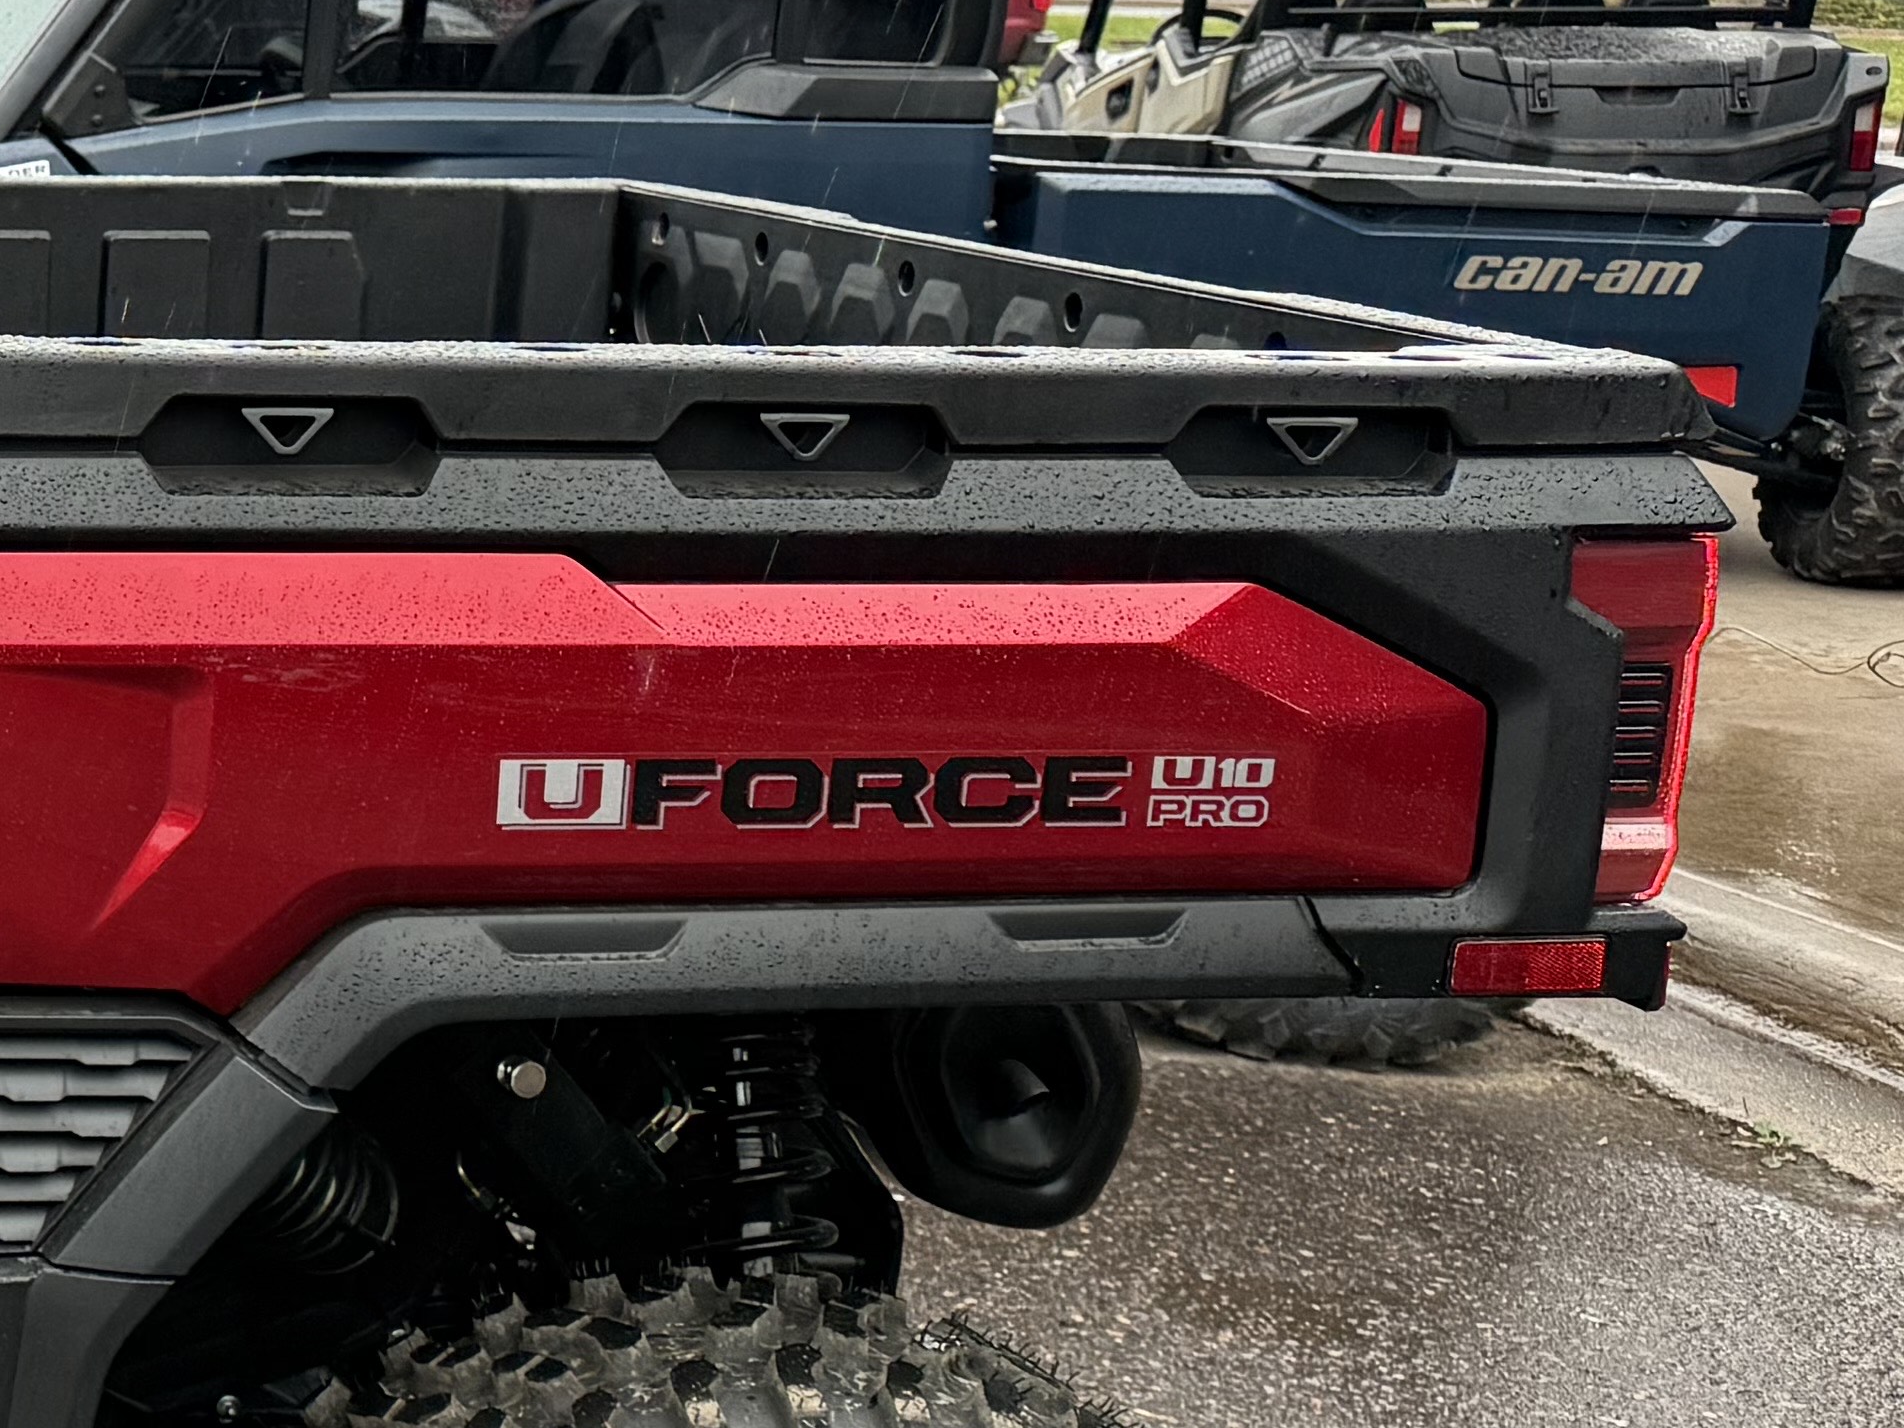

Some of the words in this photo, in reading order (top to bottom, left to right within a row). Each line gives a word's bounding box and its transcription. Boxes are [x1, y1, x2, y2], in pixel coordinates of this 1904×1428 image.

[1454, 255, 1703, 296] can-am
[1151, 756, 1276, 789] U10
[1146, 795, 1270, 828] PRO
